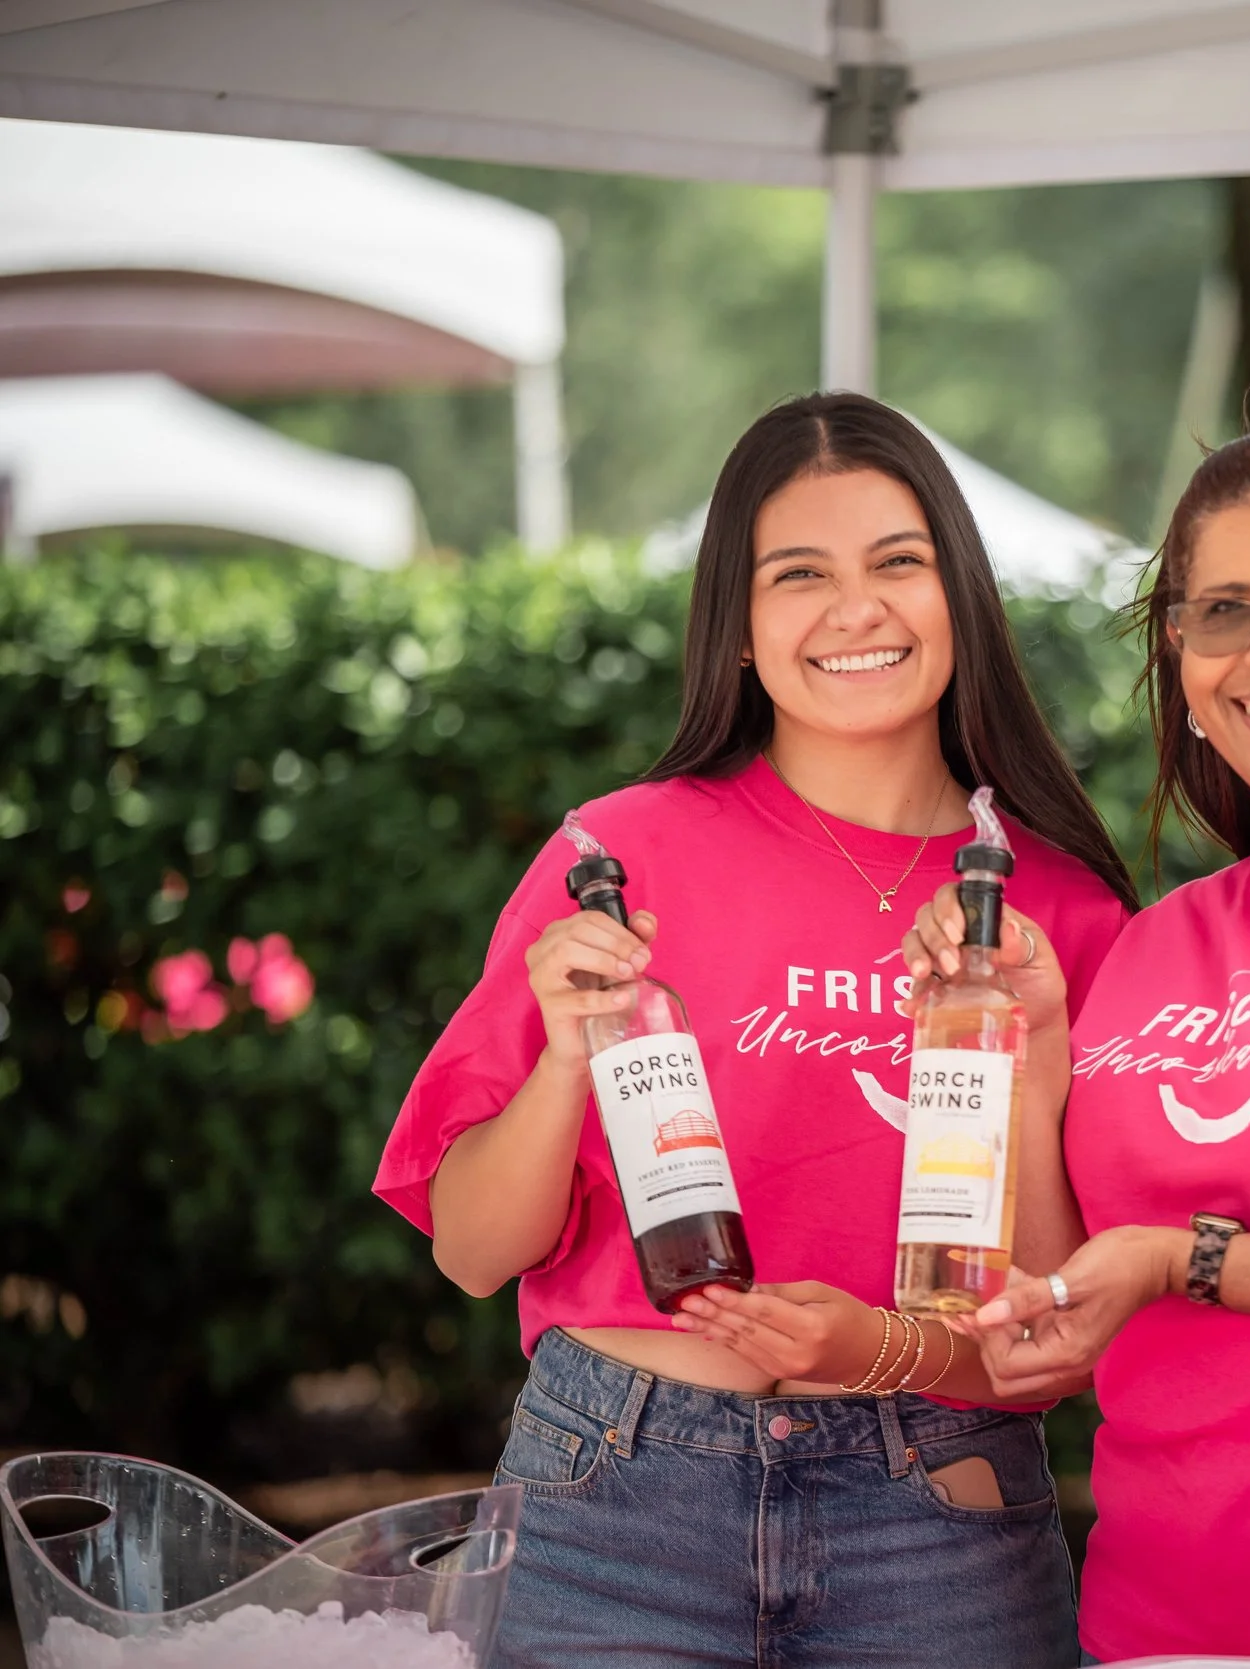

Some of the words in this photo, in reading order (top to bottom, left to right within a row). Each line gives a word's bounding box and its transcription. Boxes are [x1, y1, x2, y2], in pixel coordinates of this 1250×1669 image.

[879, 900, 892, 912] A
[787, 965, 915, 1018] FRIS
[613, 1053, 694, 1082] PORCH
[620, 1072, 698, 1101] SWING
[910, 1091, 981, 1110] SWING
[668, 1162, 686, 1172] RED
